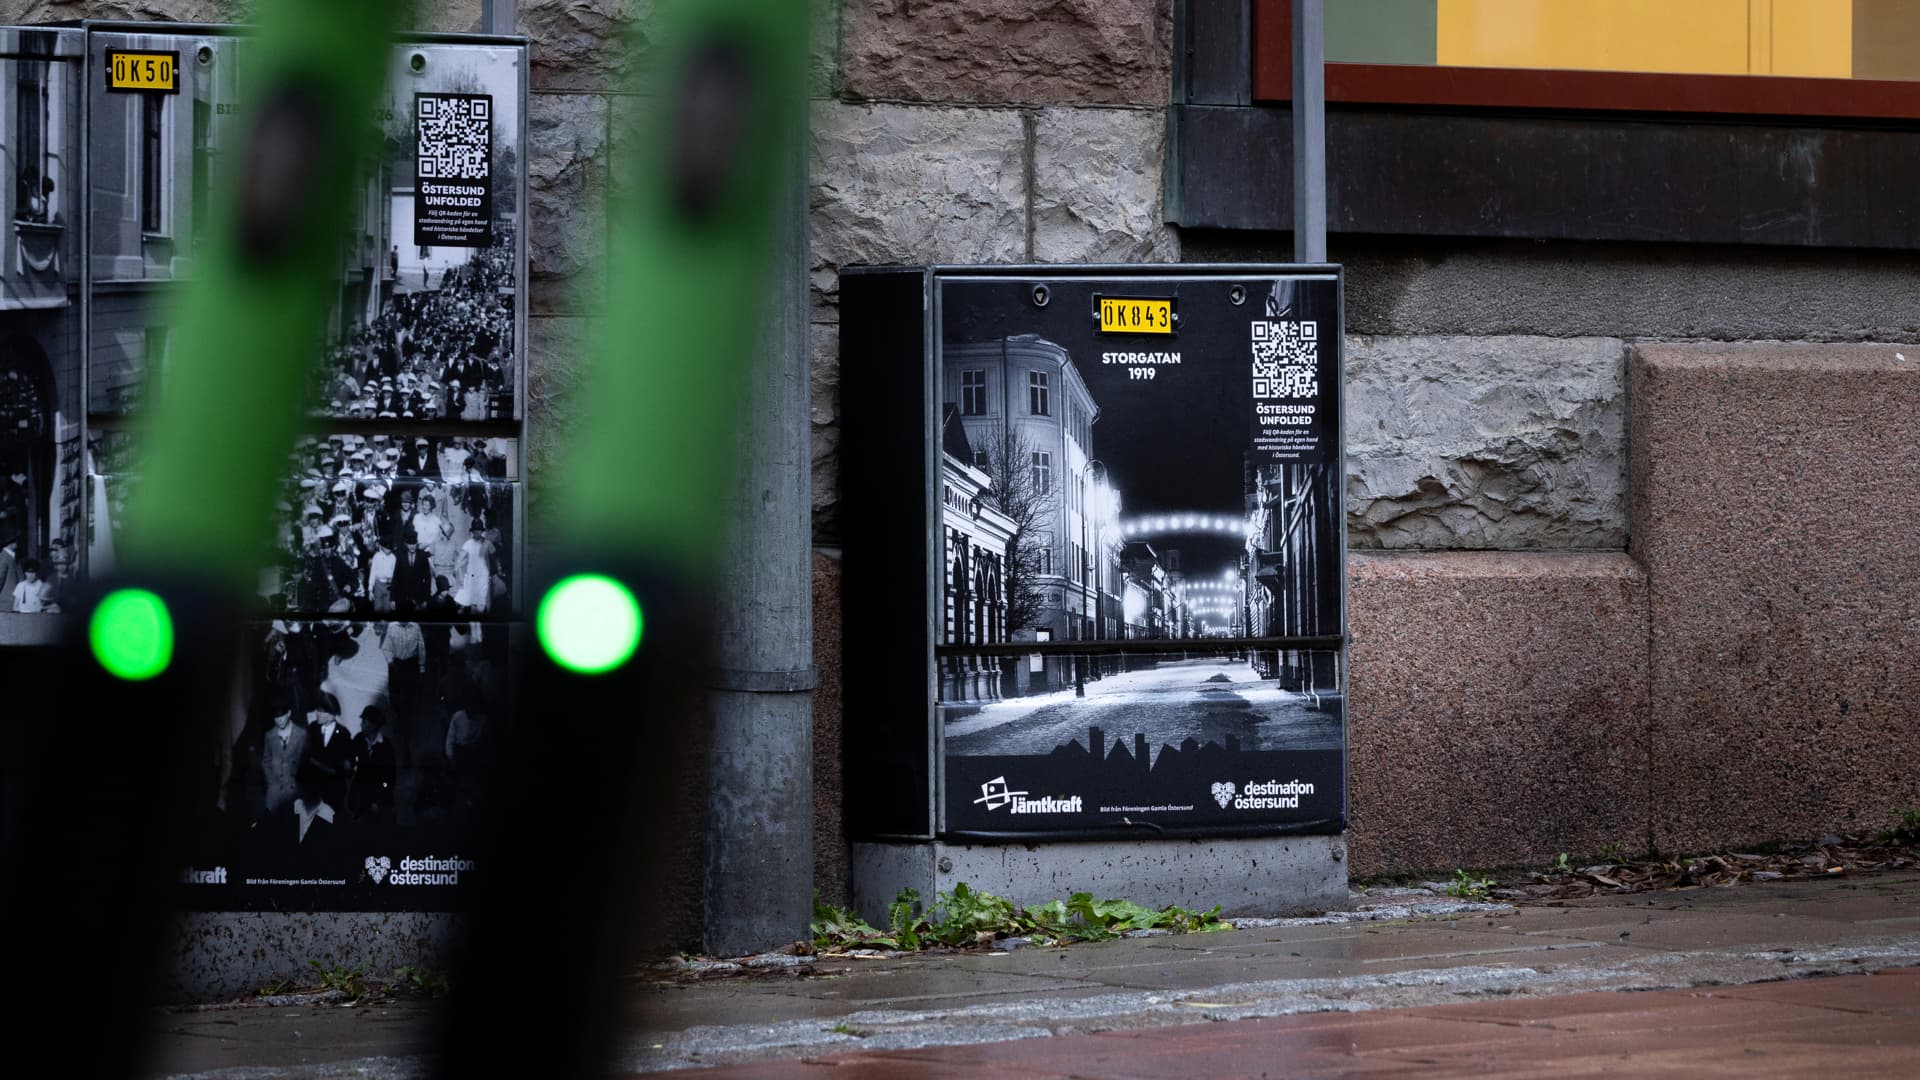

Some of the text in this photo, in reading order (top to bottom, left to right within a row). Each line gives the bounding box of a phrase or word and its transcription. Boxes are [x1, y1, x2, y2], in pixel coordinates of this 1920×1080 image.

[115, 55, 170, 83] ÖK50
[421, 181, 485, 195] ÖSTERSUND
[425, 196, 482, 207] UNFOLDED
[462, 210, 471, 218] för
[454, 218, 461, 226] på
[1104, 301, 1168, 327] ÖK843
[1102, 352, 1181, 364] STORGATAN
[1128, 367, 1156, 379] 1919
[1256, 402, 1316, 414] ÖSTERSUND
[1260, 416, 1312, 425] UNFOLDED
[1244, 779, 1314, 795] destination
[1010, 796, 1082, 814] Jämtkraft
[1234, 794, 1299, 809] östersund
[1122, 805, 1150, 813] Föreningen
[1167, 803, 1194, 811] Östersund
[400, 855, 474, 871] destination
[269, 878, 299, 886] Föreningen
[318, 877, 346, 885] Östersund
[390, 869, 458, 885] östersund
